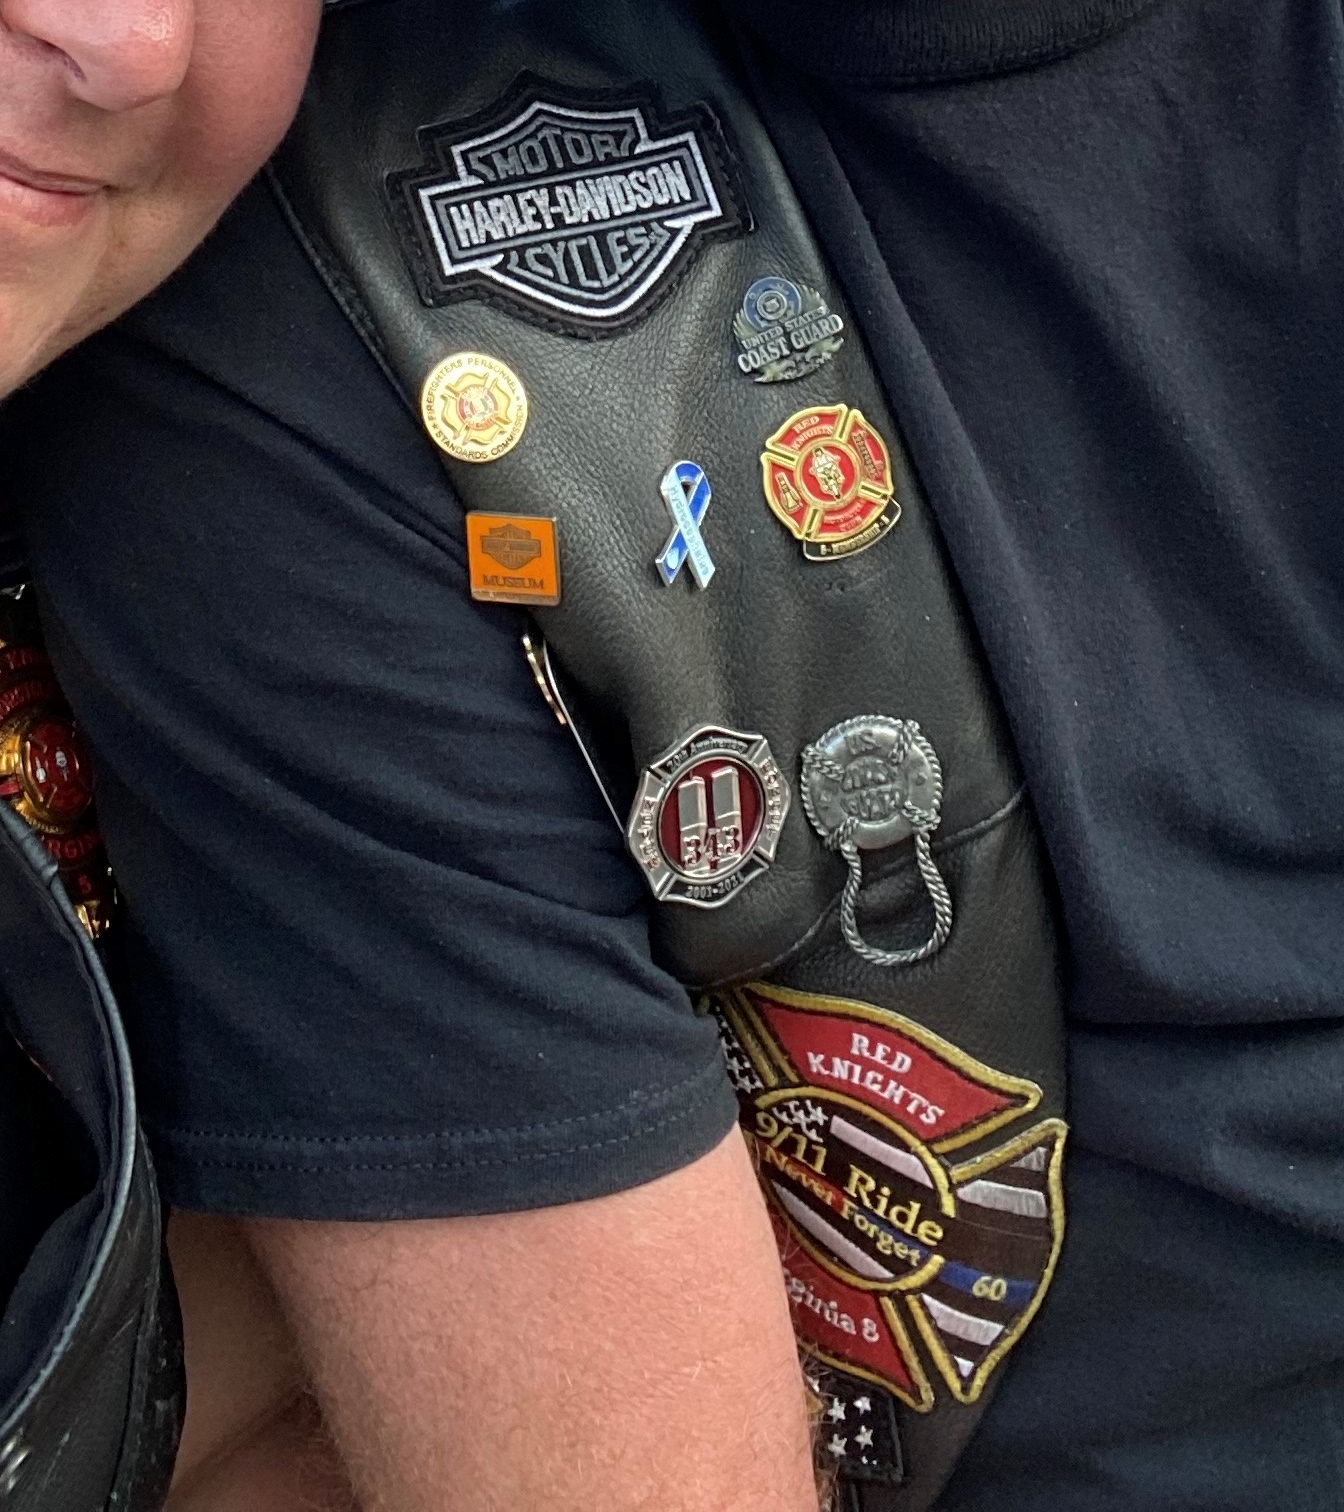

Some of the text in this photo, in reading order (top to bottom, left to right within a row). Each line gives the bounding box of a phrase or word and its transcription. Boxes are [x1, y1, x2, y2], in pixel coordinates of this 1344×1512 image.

[491, 126, 622, 180] MOTOR
[449, 159, 692, 249] HARLEY-DAVIDSON
[525, 225, 651, 288] CYCLES
[737, 336, 791, 373] COAST
[790, 313, 844, 350] GUARD
[741, 305, 830, 350] UNITED STATES
[467, 357, 517, 395] PERSONNEL
[435, 430, 489, 460] STANDARDS
[792, 415, 820, 434] RED
[482, 574, 545, 590] MUSEUM
[684, 826, 741, 871] 343
[686, 870, 746, 900] 2001-2021
[849, 1032, 913, 1074] RED
[805, 1051, 946, 1126] KNIGHTS
[756, 1111, 945, 1247] 9/11 Ride
[765, 1144, 921, 1267] Never Forget
[971, 1275, 1008, 1302] 60
[861, 1317, 880, 1343] 8
